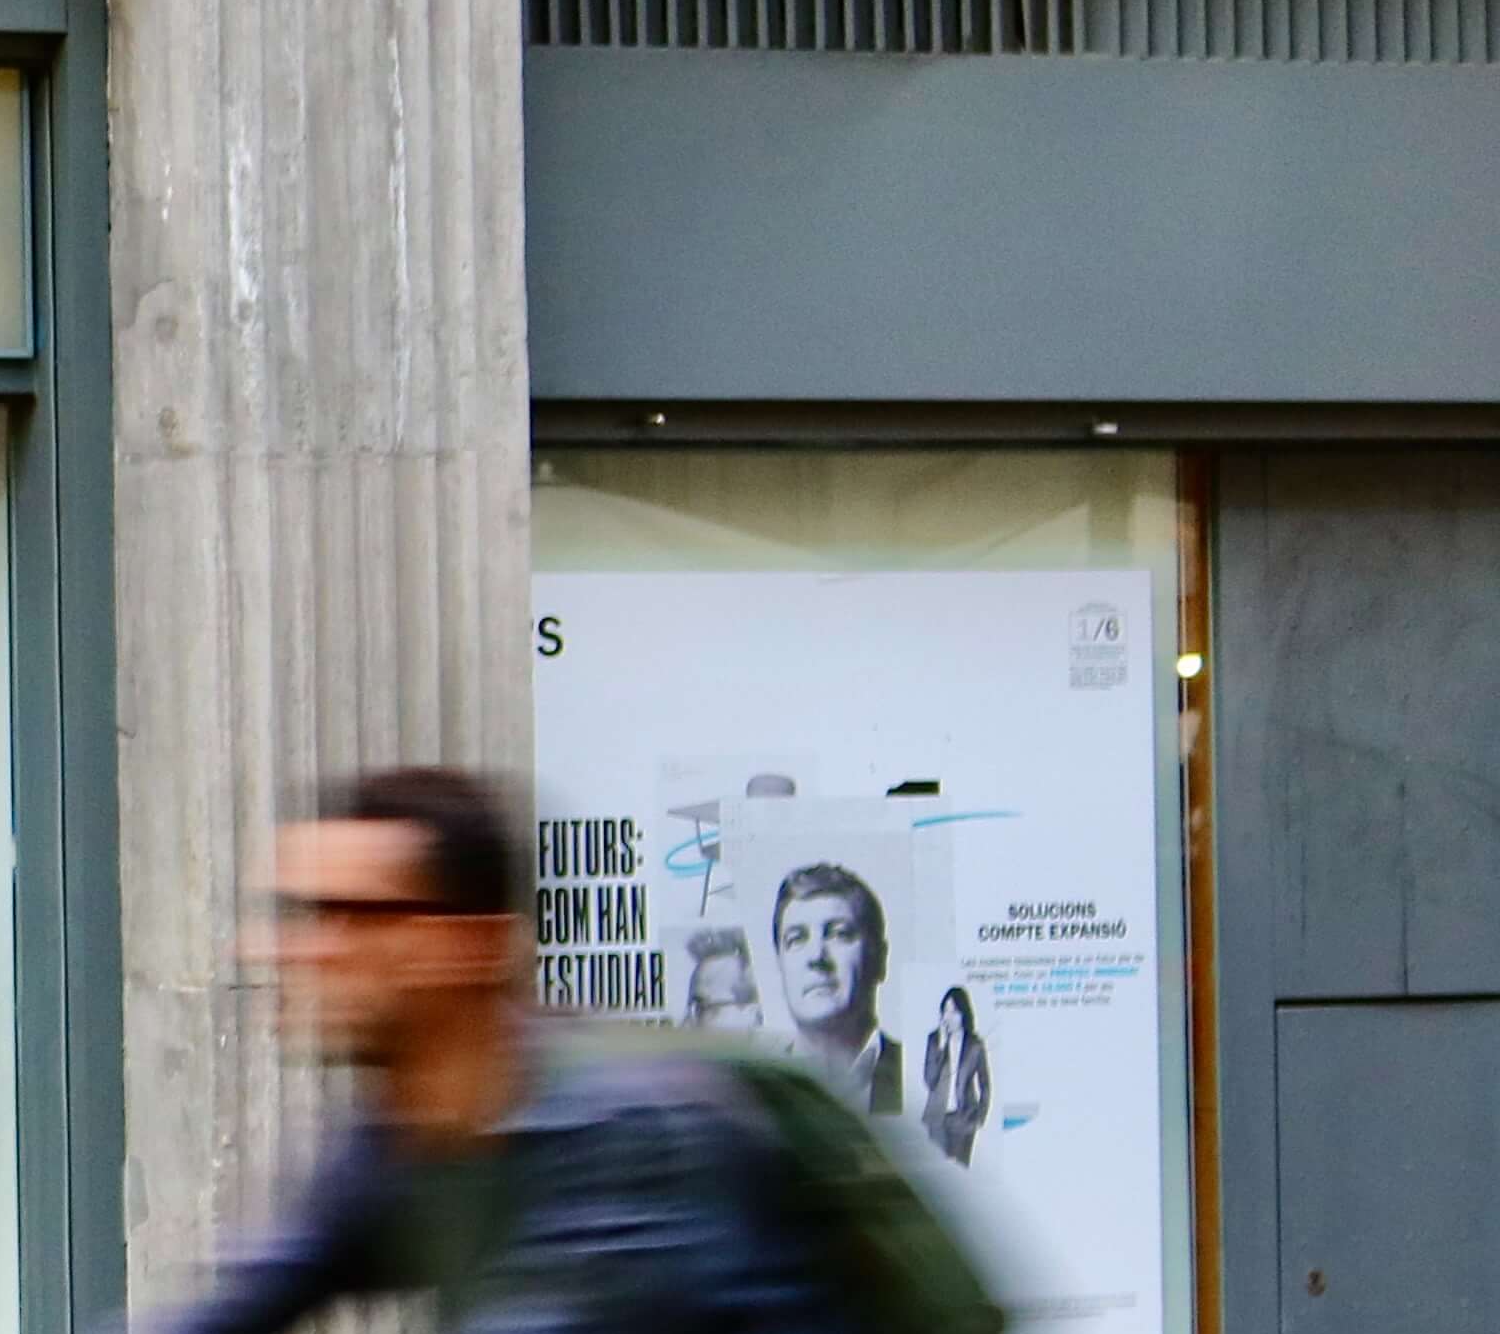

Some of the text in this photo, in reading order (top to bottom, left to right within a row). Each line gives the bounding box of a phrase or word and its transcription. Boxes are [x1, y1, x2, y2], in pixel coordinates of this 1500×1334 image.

[539, 818, 643, 879] FUTURS:
[537, 884, 647, 945] COM HAN
[978, 919, 1127, 942] COMPTE EXPANSIÓ
[1008, 901, 1097, 921] SOLUCIONS
